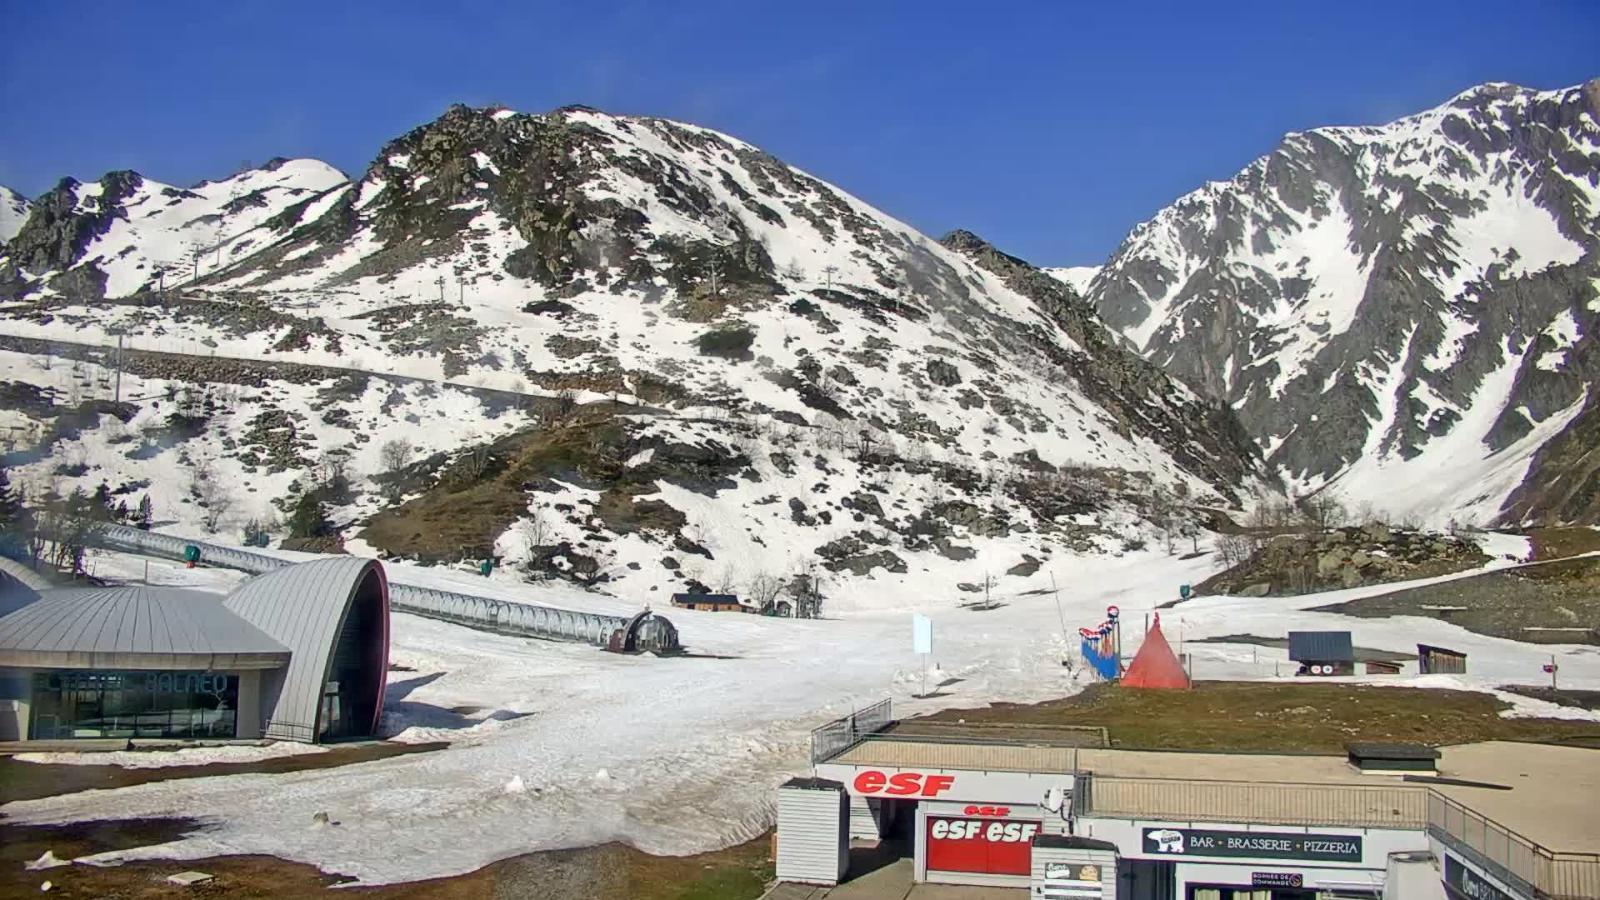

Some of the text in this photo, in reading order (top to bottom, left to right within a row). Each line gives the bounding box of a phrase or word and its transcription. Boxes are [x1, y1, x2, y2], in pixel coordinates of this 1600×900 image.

[1190, 837, 1215, 849] BAR
[1227, 838, 1292, 851] BRASSERIE
[1303, 841, 1358, 854] PIZZERIA
